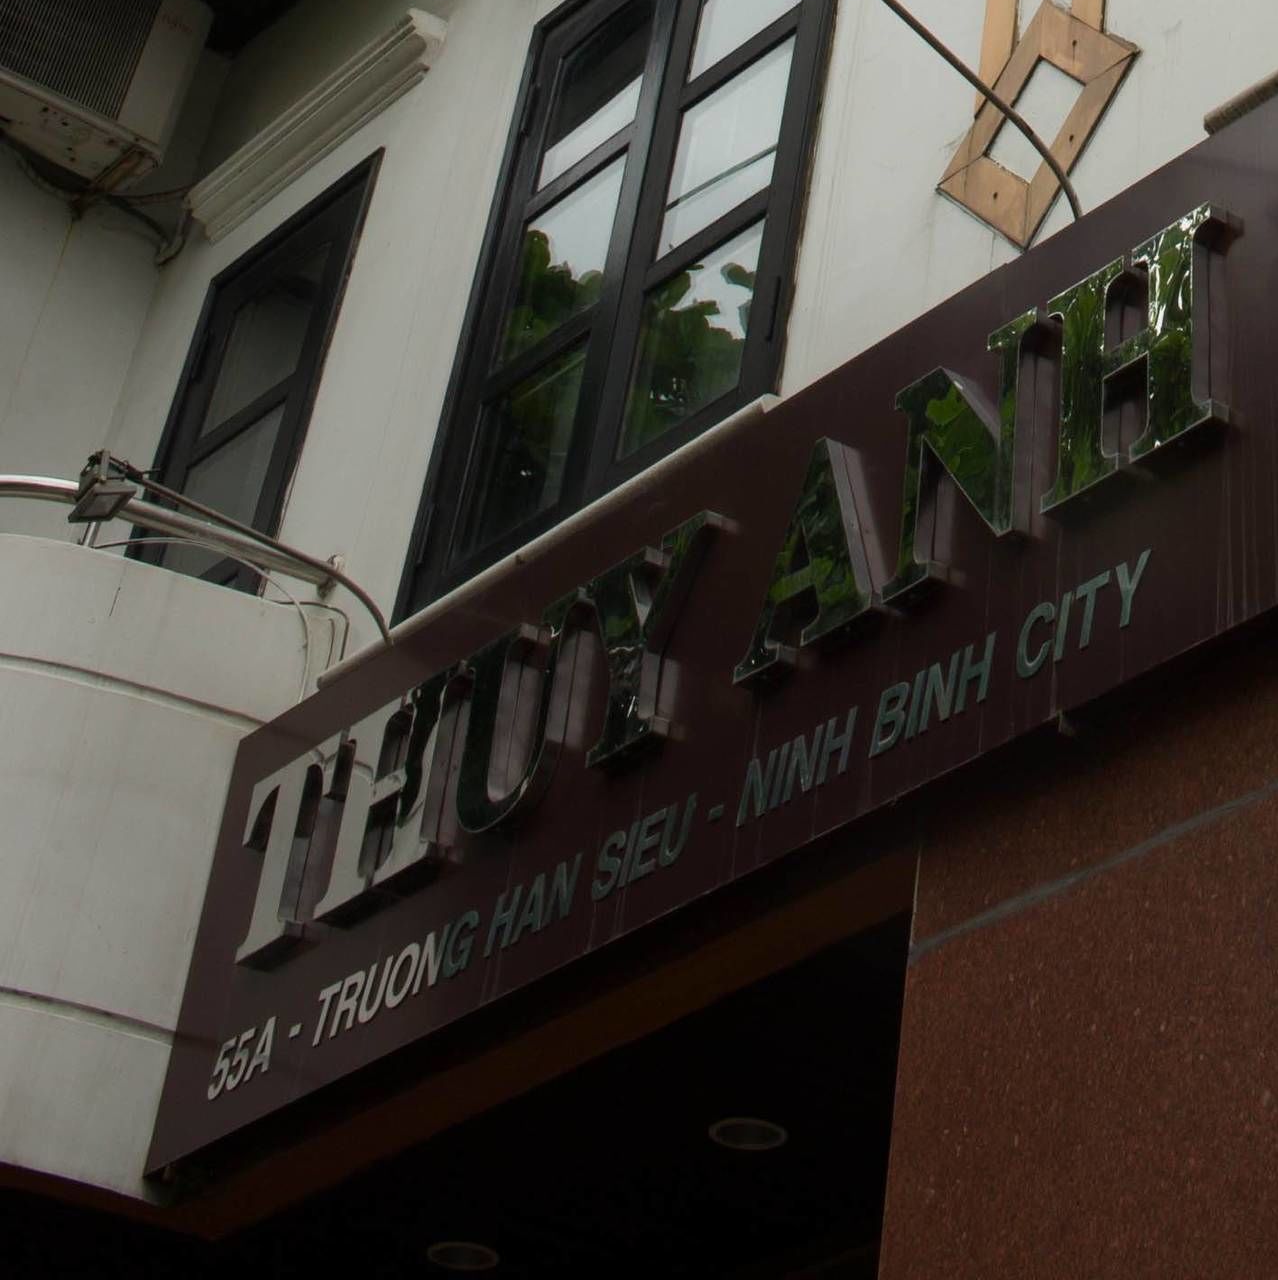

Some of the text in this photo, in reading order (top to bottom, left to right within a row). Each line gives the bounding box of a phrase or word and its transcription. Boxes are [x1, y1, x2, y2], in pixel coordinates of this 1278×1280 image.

[206, 1015, 278, 1101] 55A
[311, 910, 481, 1048] TRUONG
[482, 852, 584, 959] HAN
[590, 792, 698, 902] SIEU
[735, 704, 859, 828] NINH
[868, 631, 997, 759] BINH
[1015, 548, 1152, 679] CITY
[234, 509, 728, 970] THUY
[732, 200, 1238, 684] ANH
